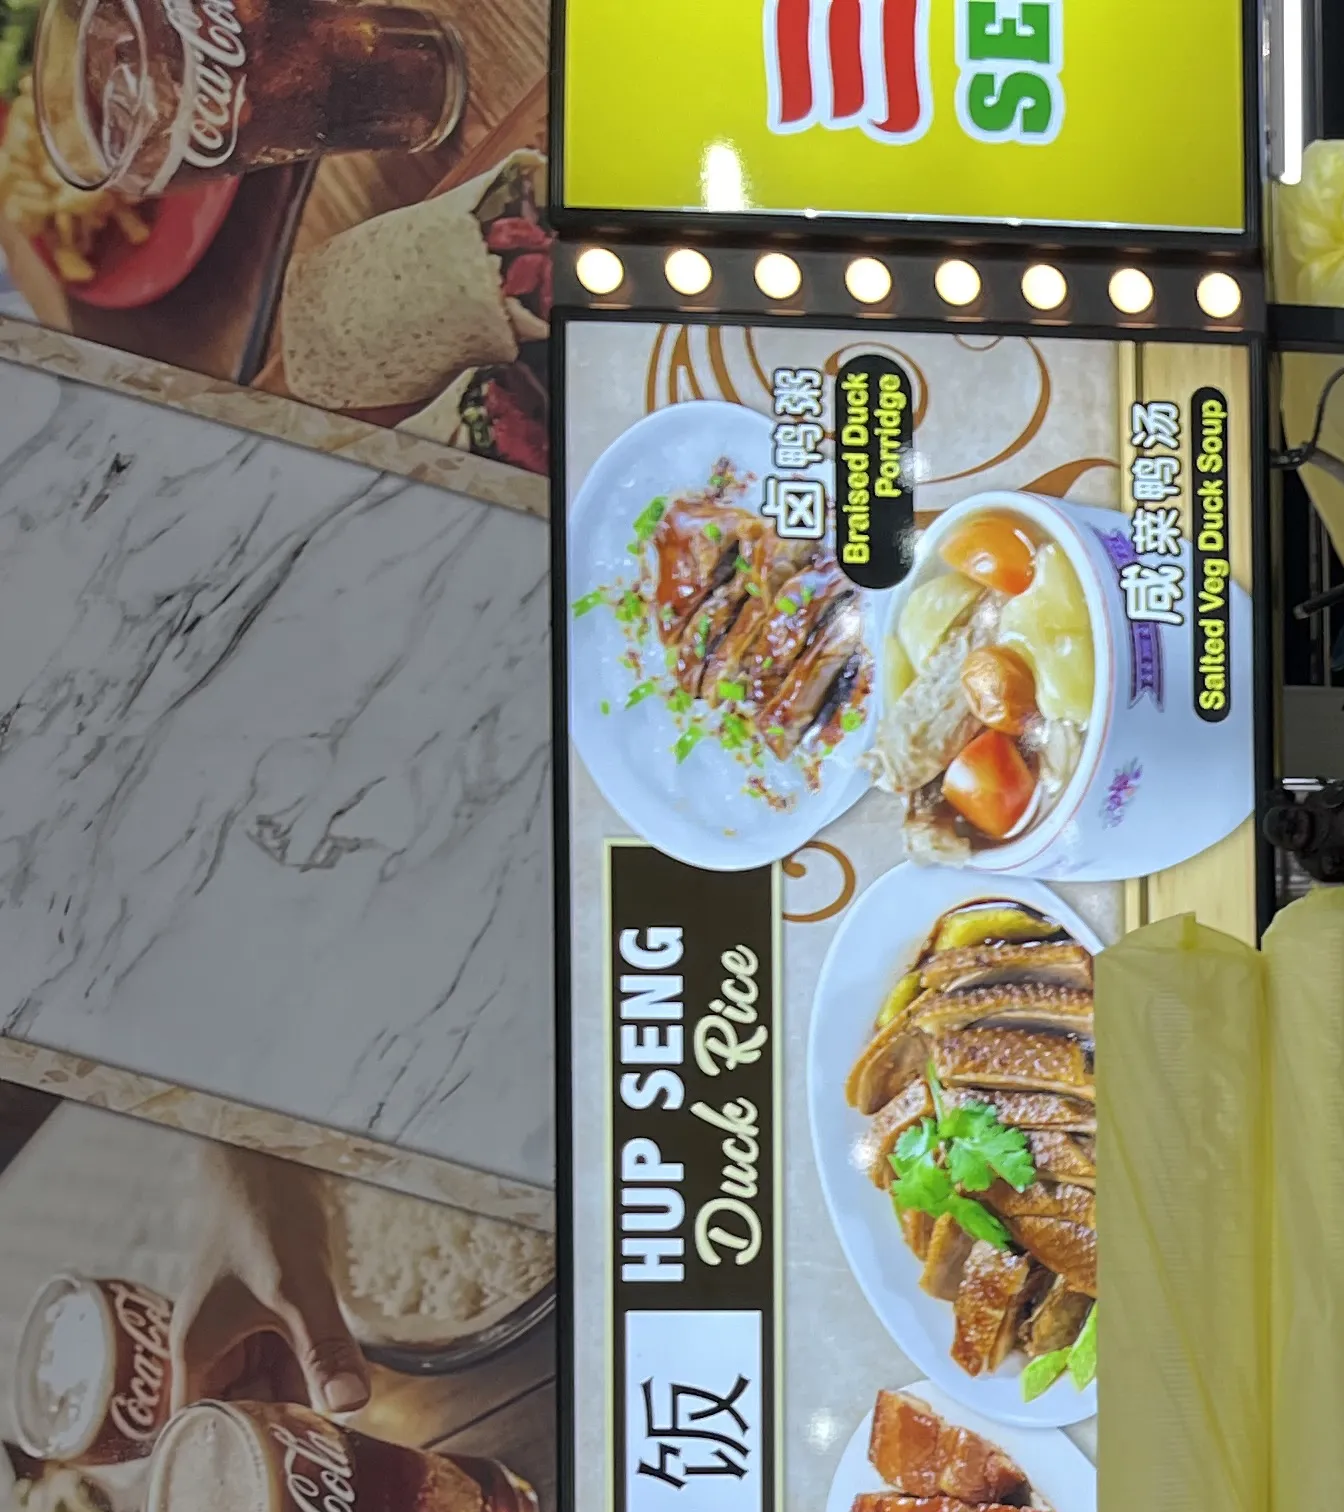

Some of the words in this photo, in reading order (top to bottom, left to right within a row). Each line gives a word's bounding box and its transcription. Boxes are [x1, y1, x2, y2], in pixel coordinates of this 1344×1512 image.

[162, 0, 247, 167] Coca-Co
[761, 366, 826, 539] 卤鸭粥
[842, 373, 871, 447] Duck
[873, 373, 904, 498] Porridge
[1199, 399, 1229, 473] Soup
[842, 453, 871, 564] Braised
[1121, 400, 1186, 624] 咸菜鸭汤
[1199, 479, 1226, 552] Duck
[1199, 558, 1230, 613] Veg
[1198, 618, 1227, 711] Salted
[619, 926, 687, 1111] SENG
[693, 944, 768, 1077] Rice
[619, 1137, 687, 1283] HUP
[689, 1096, 761, 1266] Duck
